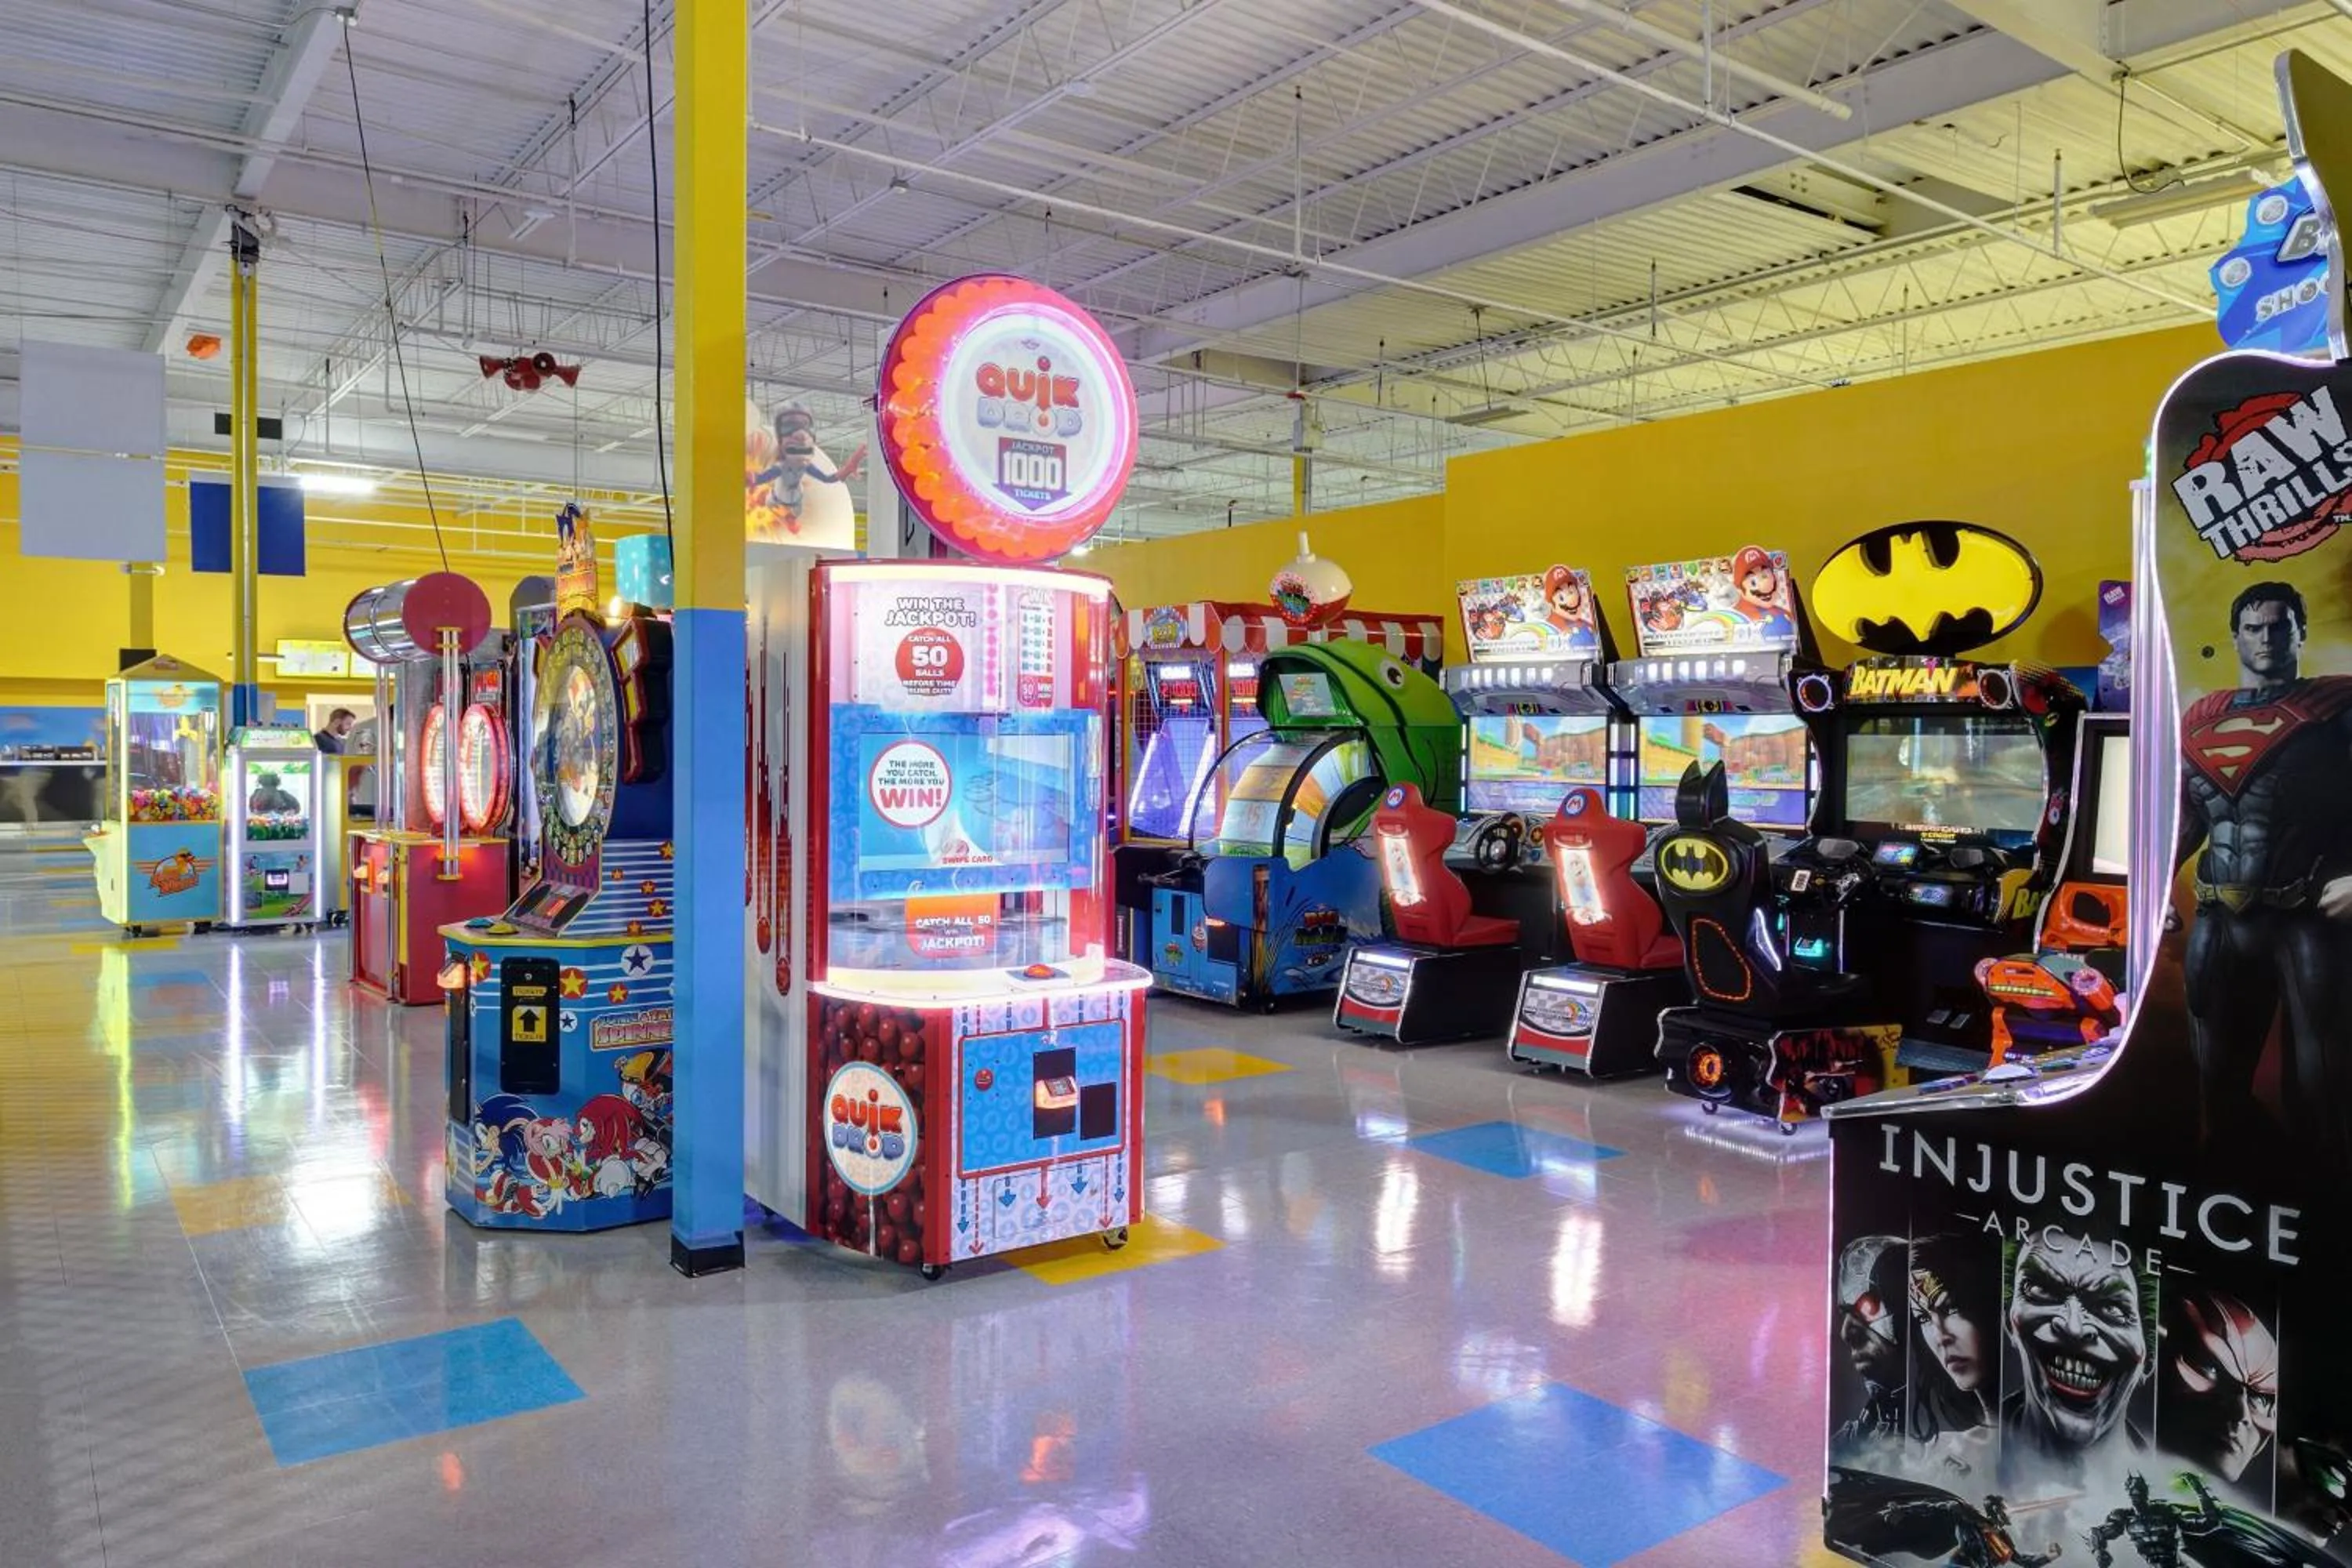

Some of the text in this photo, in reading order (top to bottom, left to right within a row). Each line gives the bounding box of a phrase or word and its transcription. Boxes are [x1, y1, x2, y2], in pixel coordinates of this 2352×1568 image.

[1011, 441, 1055, 456] JACKPOT
[2172, 385, 2347, 530] RAW
[1004, 451, 1063, 491] 1000
[1014, 488, 1051, 501] TICKETS
[896, 597, 965, 612] WIN THE
[884, 610, 977, 628] JACKPOT!
[911, 644, 949, 667] 50
[1850, 666, 1958, 695] BATMAN
[889, 760, 907, 768] THE
[879, 787, 942, 808] WIN!
[915, 915, 991, 928] CATCH ALL 50
[921, 935, 985, 951] JACKPOT!
[597, 1022, 673, 1044] SPINNE
[1878, 1123, 2301, 1265] INJUSTICE
[1983, 1210, 2162, 1277] ARCADE
